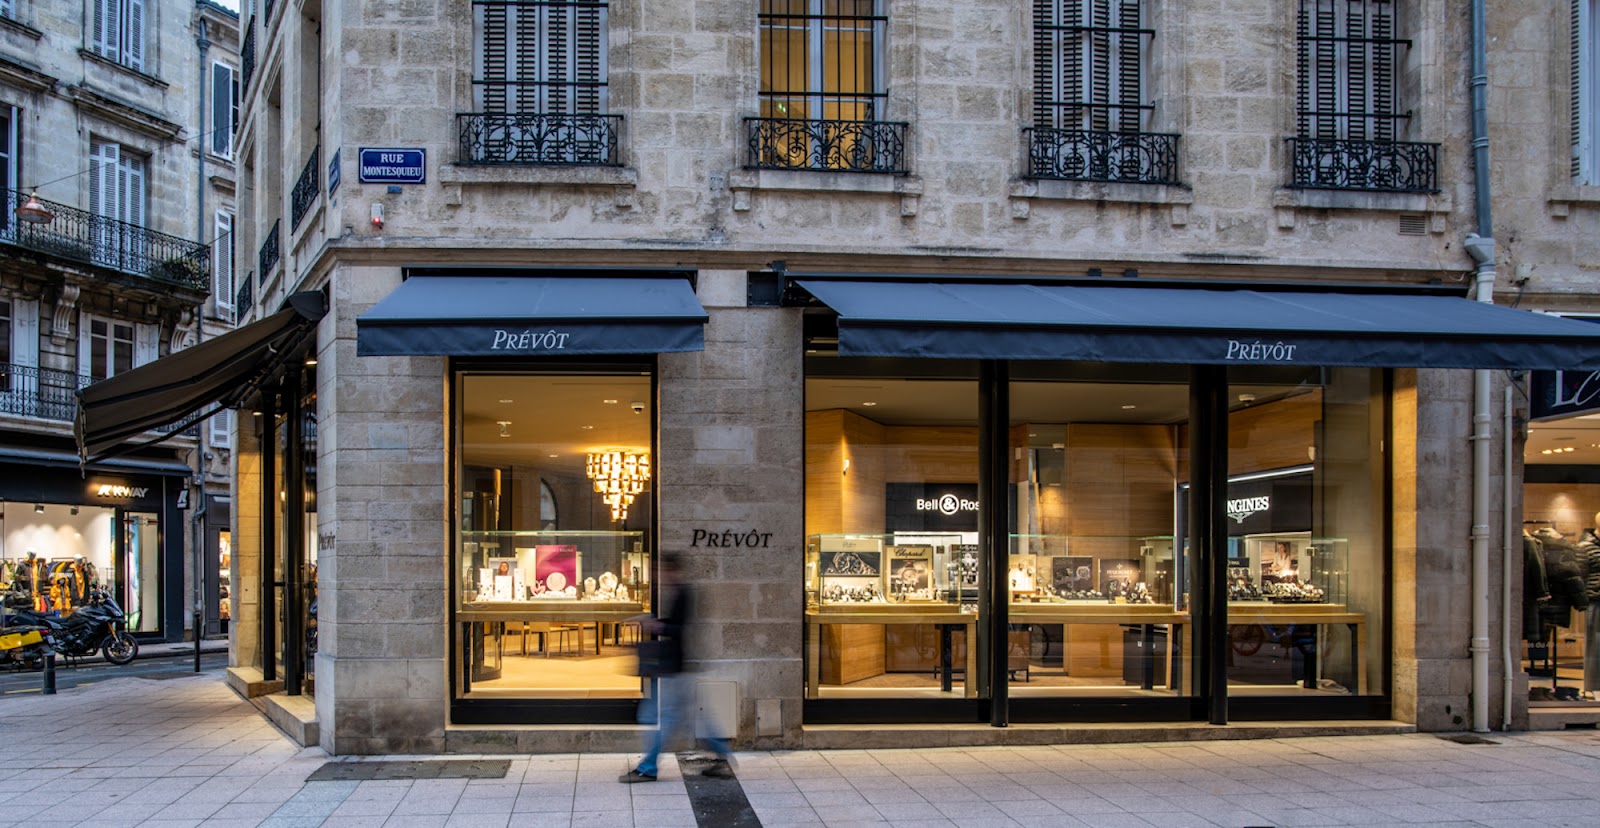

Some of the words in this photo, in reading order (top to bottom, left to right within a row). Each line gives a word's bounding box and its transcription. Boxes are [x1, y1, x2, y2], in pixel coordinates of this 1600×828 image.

[380, 153, 404, 163] RUE
[363, 166, 421, 178] MONTESQUIEU
[491, 329, 570, 350] PRÉVÔT
[1225, 339, 1297, 361] PRÉVÔT
[916, 498, 938, 510] Bell
[1227, 496, 1270, 513] NGINES
[689, 528, 773, 549] PRÉVÔT
